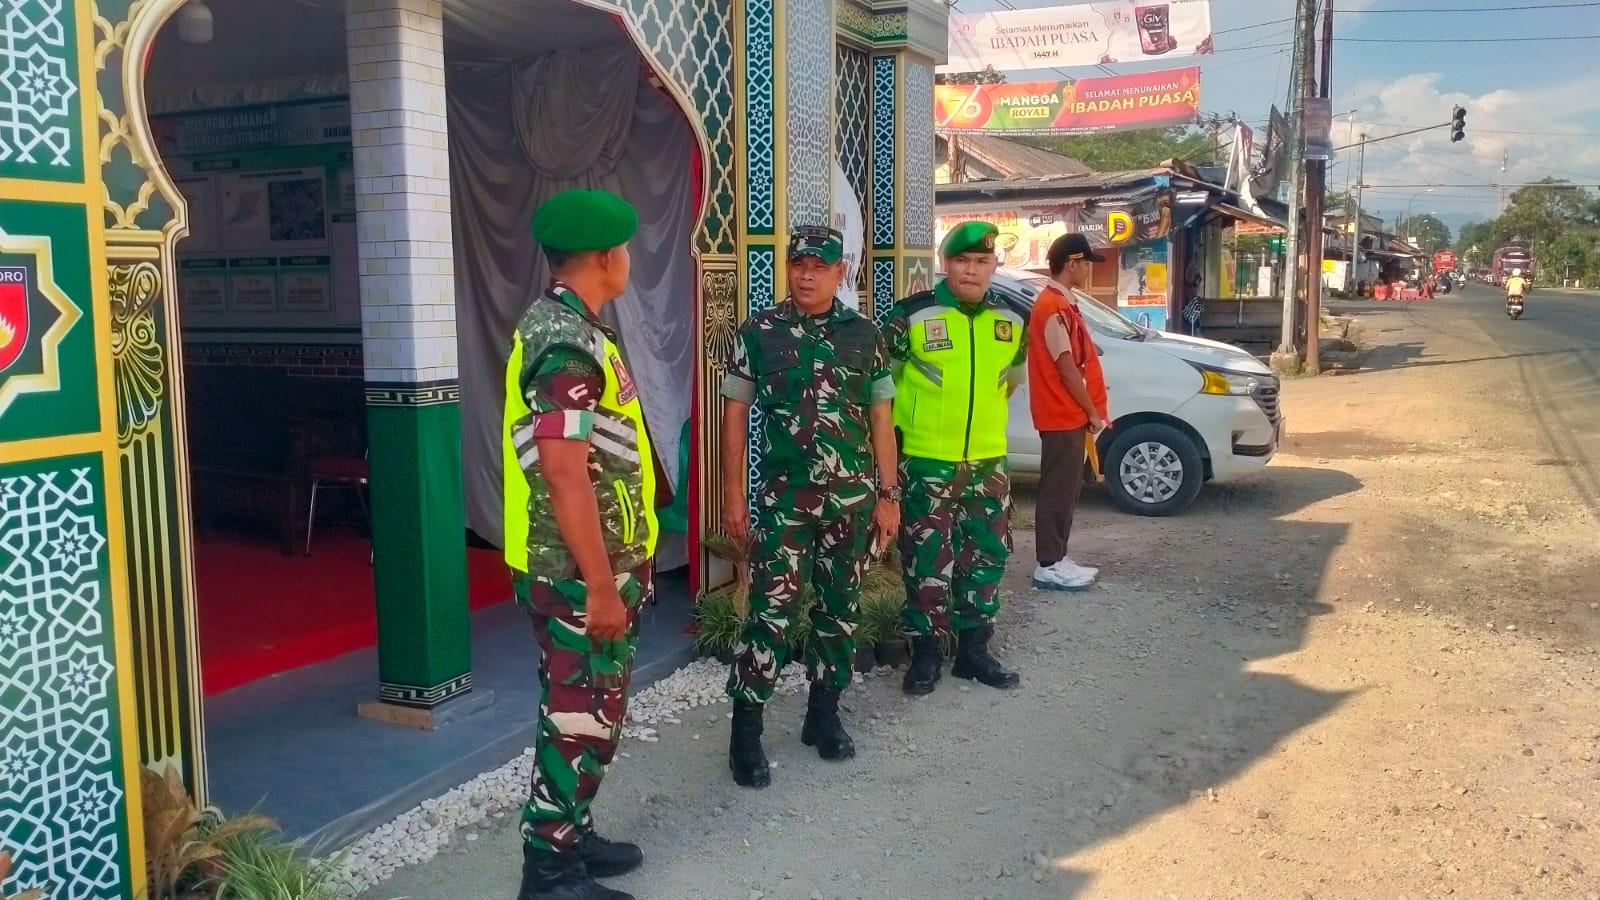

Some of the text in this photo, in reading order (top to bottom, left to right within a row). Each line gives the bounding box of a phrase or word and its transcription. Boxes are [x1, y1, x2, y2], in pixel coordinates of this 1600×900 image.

[995, 20, 1089, 35] Selamat Menunaikan
[990, 31, 1099, 50] IBADAH PUASA
[1033, 51, 1051, 59] 1447
[1084, 82, 1179, 99] SELAMAT MENUNAIKAN
[1000, 93, 1060, 106] MANGGA
[1070, 90, 1195, 114] IBADAH PUASA
[1011, 107, 1048, 118] ROYAL
